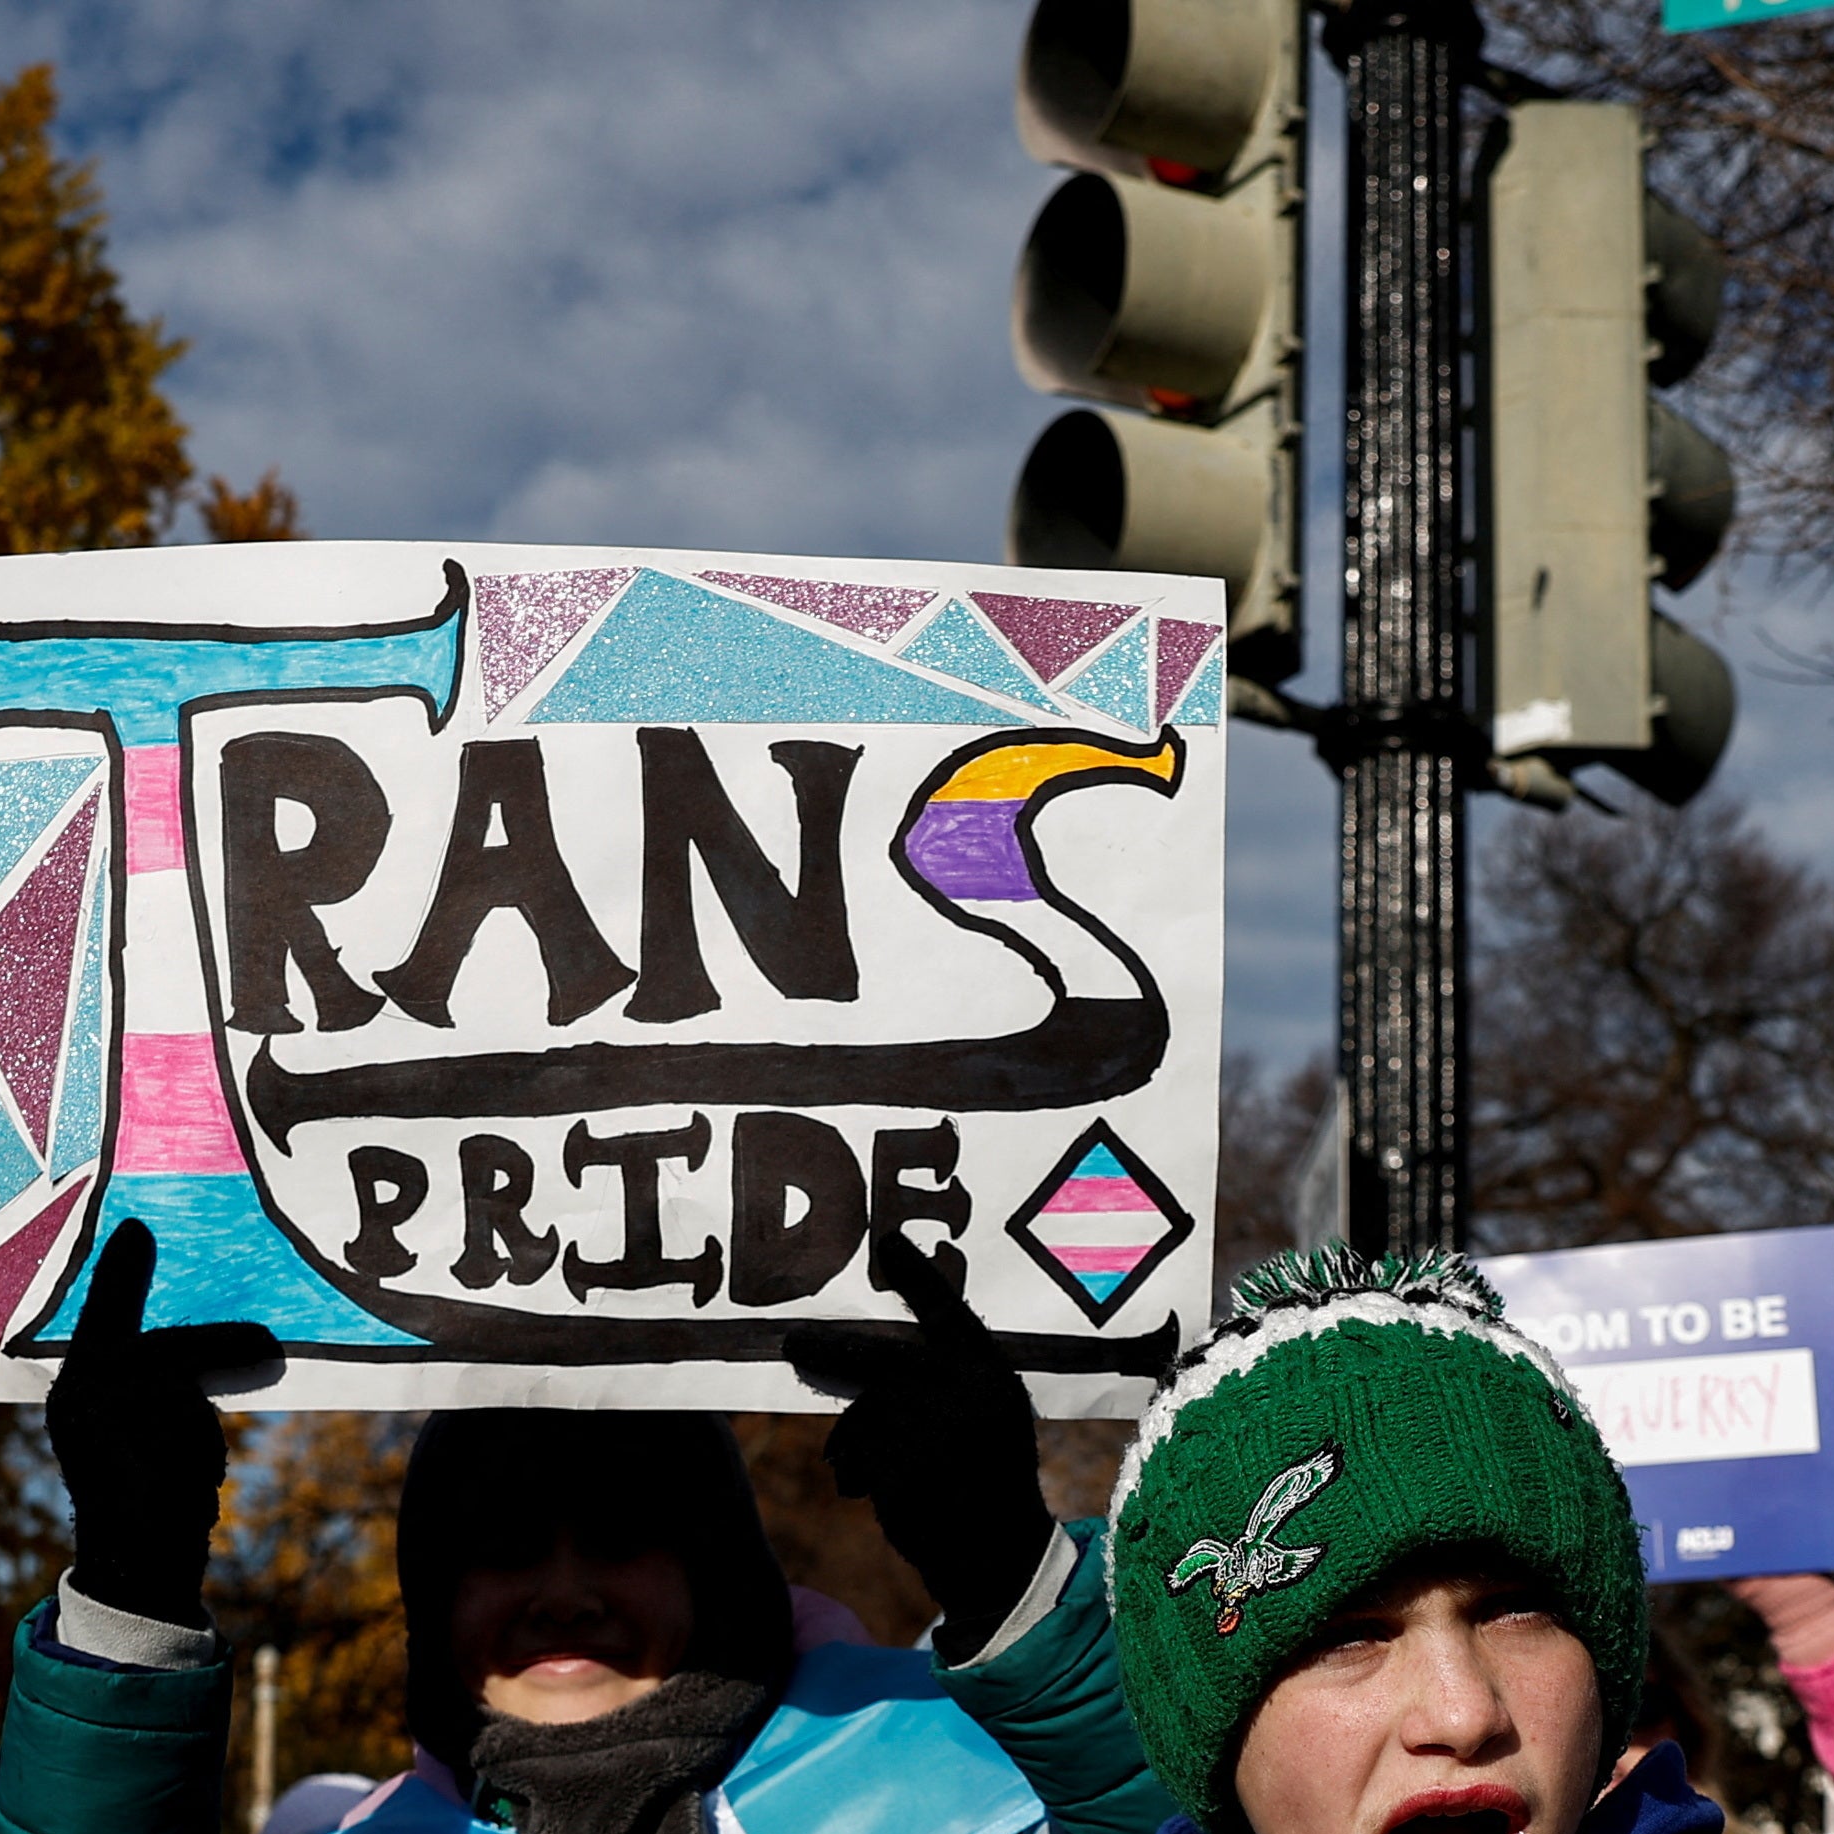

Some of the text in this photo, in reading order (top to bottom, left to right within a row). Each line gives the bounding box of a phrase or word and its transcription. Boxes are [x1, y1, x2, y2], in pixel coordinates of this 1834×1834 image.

[344, 1112, 970, 1308] PRIDE
[1638, 1302, 1711, 1346] TO
[1720, 1295, 1789, 1341] BE
